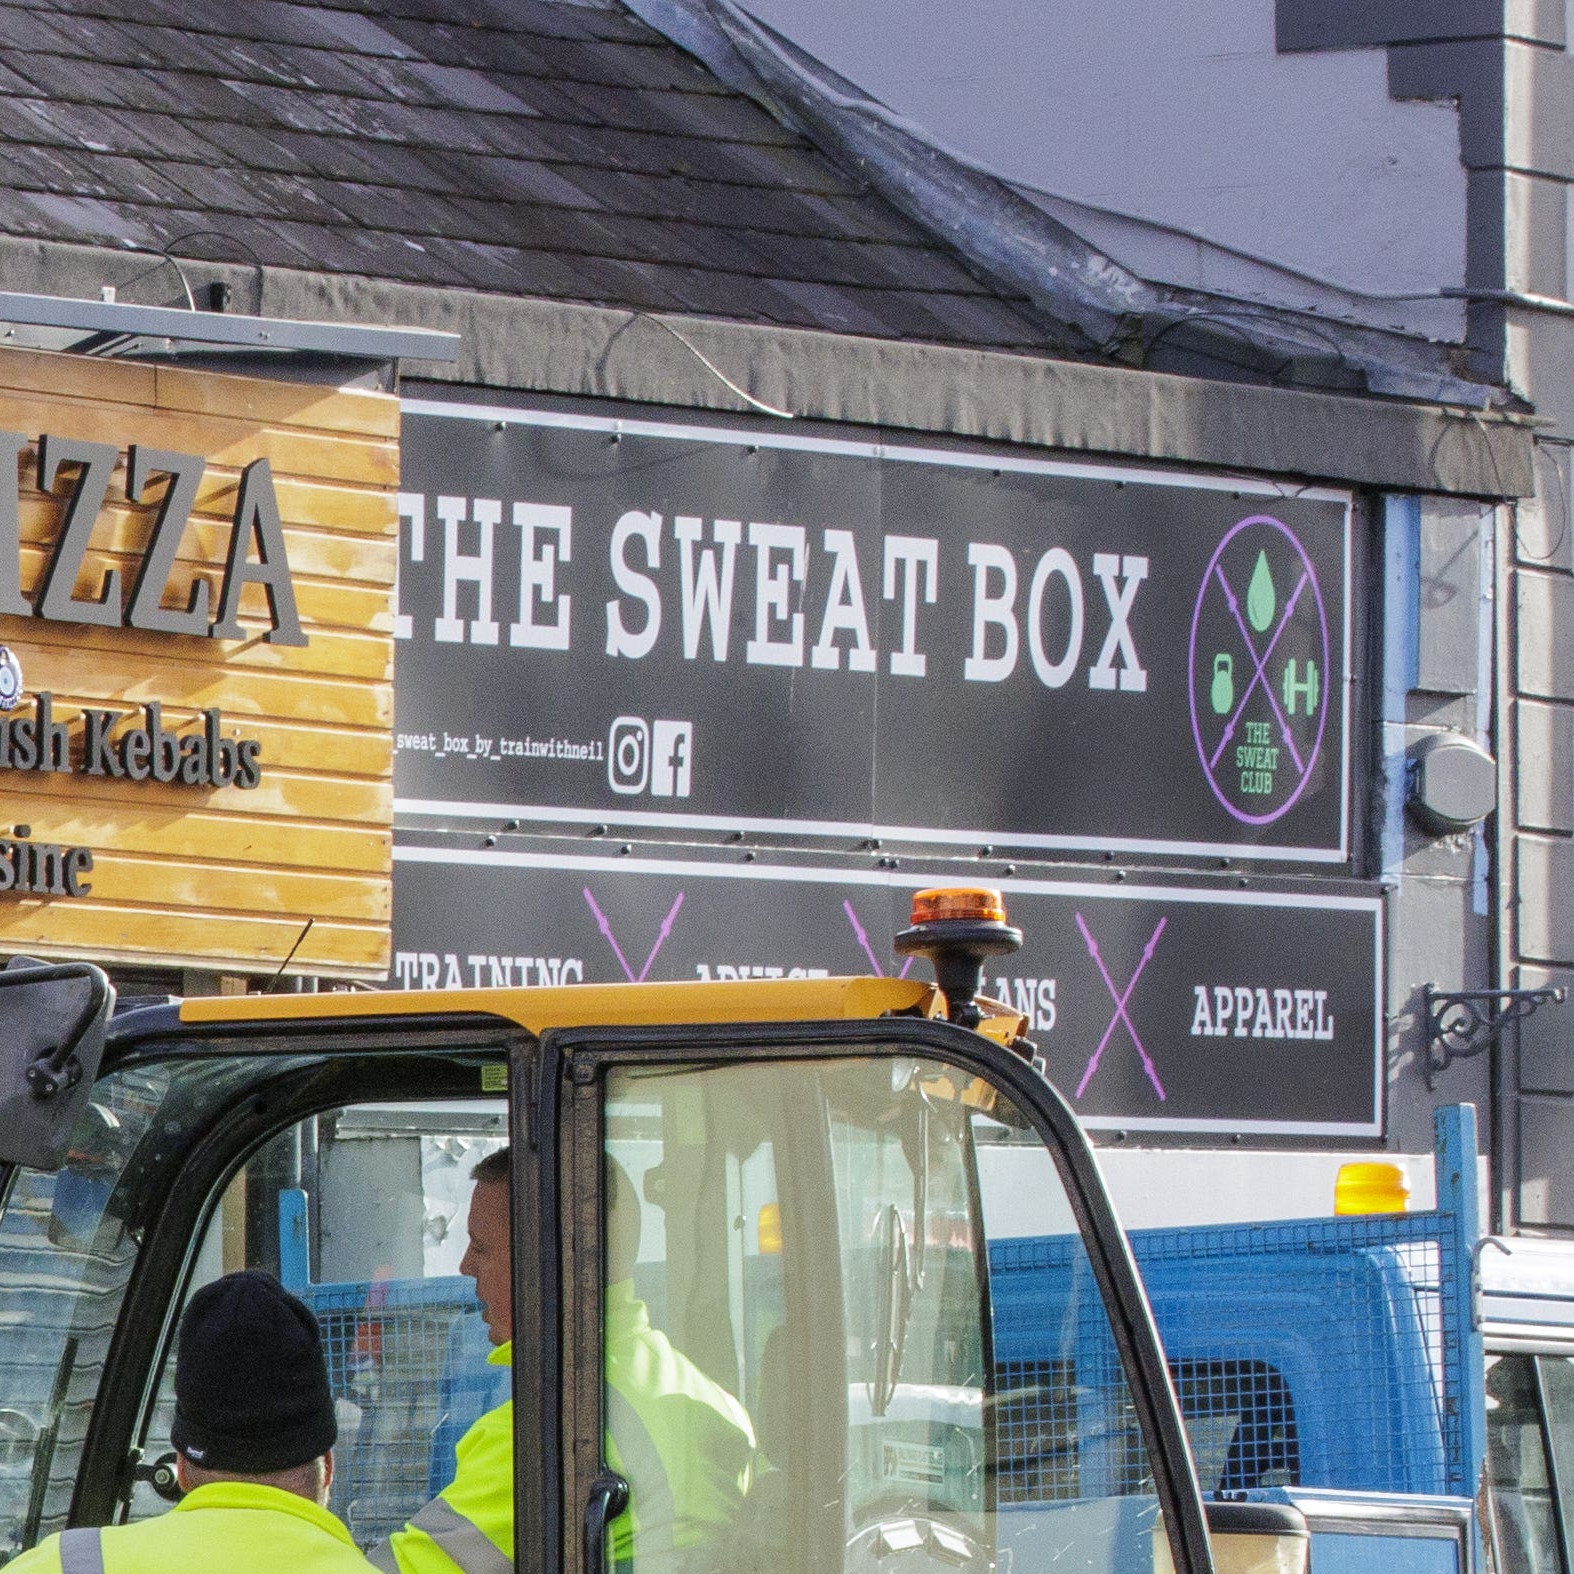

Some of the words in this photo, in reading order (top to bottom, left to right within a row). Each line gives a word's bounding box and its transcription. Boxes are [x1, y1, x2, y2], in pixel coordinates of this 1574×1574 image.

[605, 510, 939, 677] SWEAT
[964, 542, 1149, 692] BOX
[82, 701, 262, 790] Kebabs
[1245, 722, 1270, 744] THE
[1236, 746, 1279, 769] SWEAT
[1241, 771, 1272, 794] CLUB
[1191, 985, 1335, 1040] APPAREL
